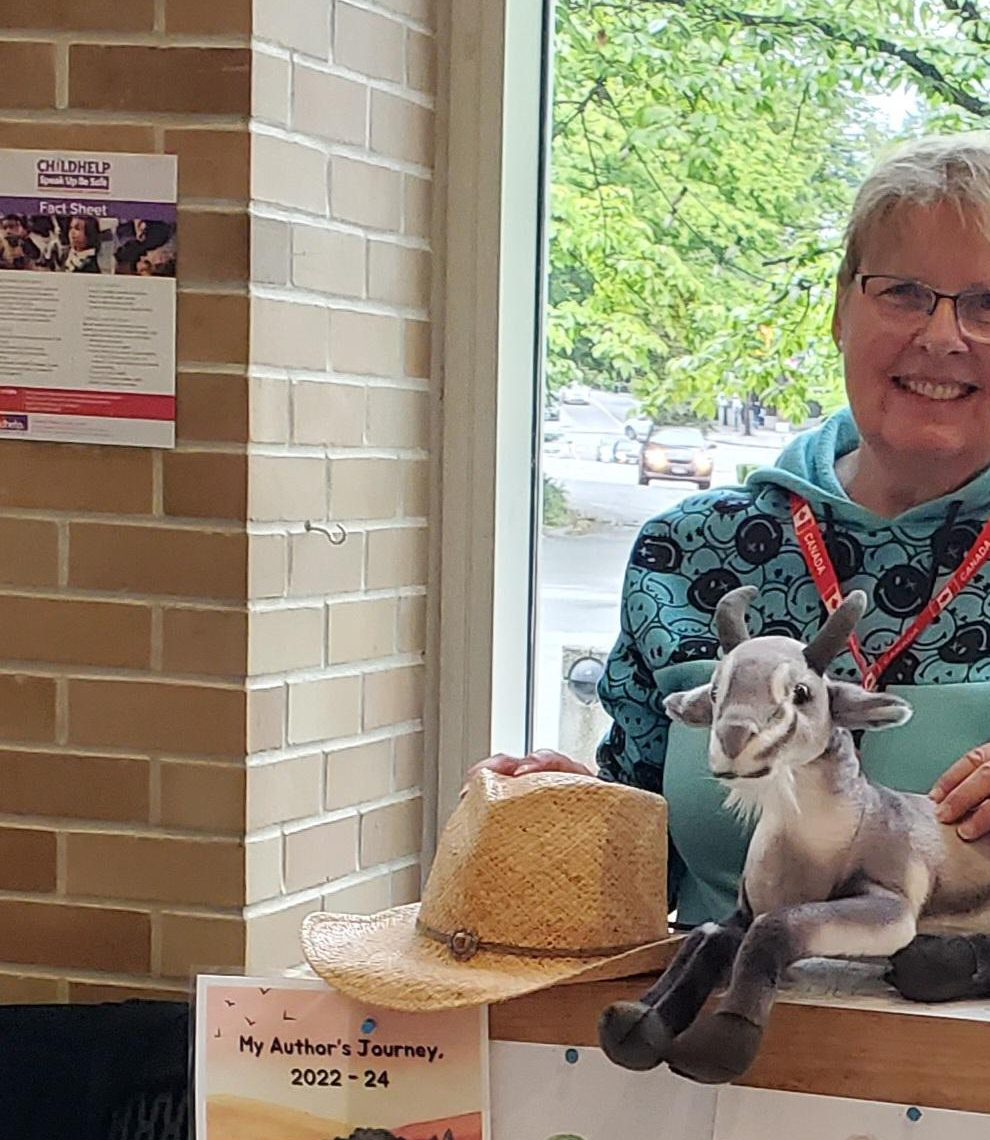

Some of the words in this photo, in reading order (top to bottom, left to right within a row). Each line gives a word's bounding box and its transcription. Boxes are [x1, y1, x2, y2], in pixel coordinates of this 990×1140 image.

[37, 159, 111, 174] CHILDHELP
[40, 201, 66, 215] Fact
[70, 202, 107, 217] Sheet
[803, 531, 826, 576] CANADA
[239, 1035, 262, 1058] My
[270, 1038, 352, 1058] Author's
[357, 1038, 445, 1061] Journey,
[290, 1068, 343, 1088] 2022
[364, 1069, 391, 1089] 24
